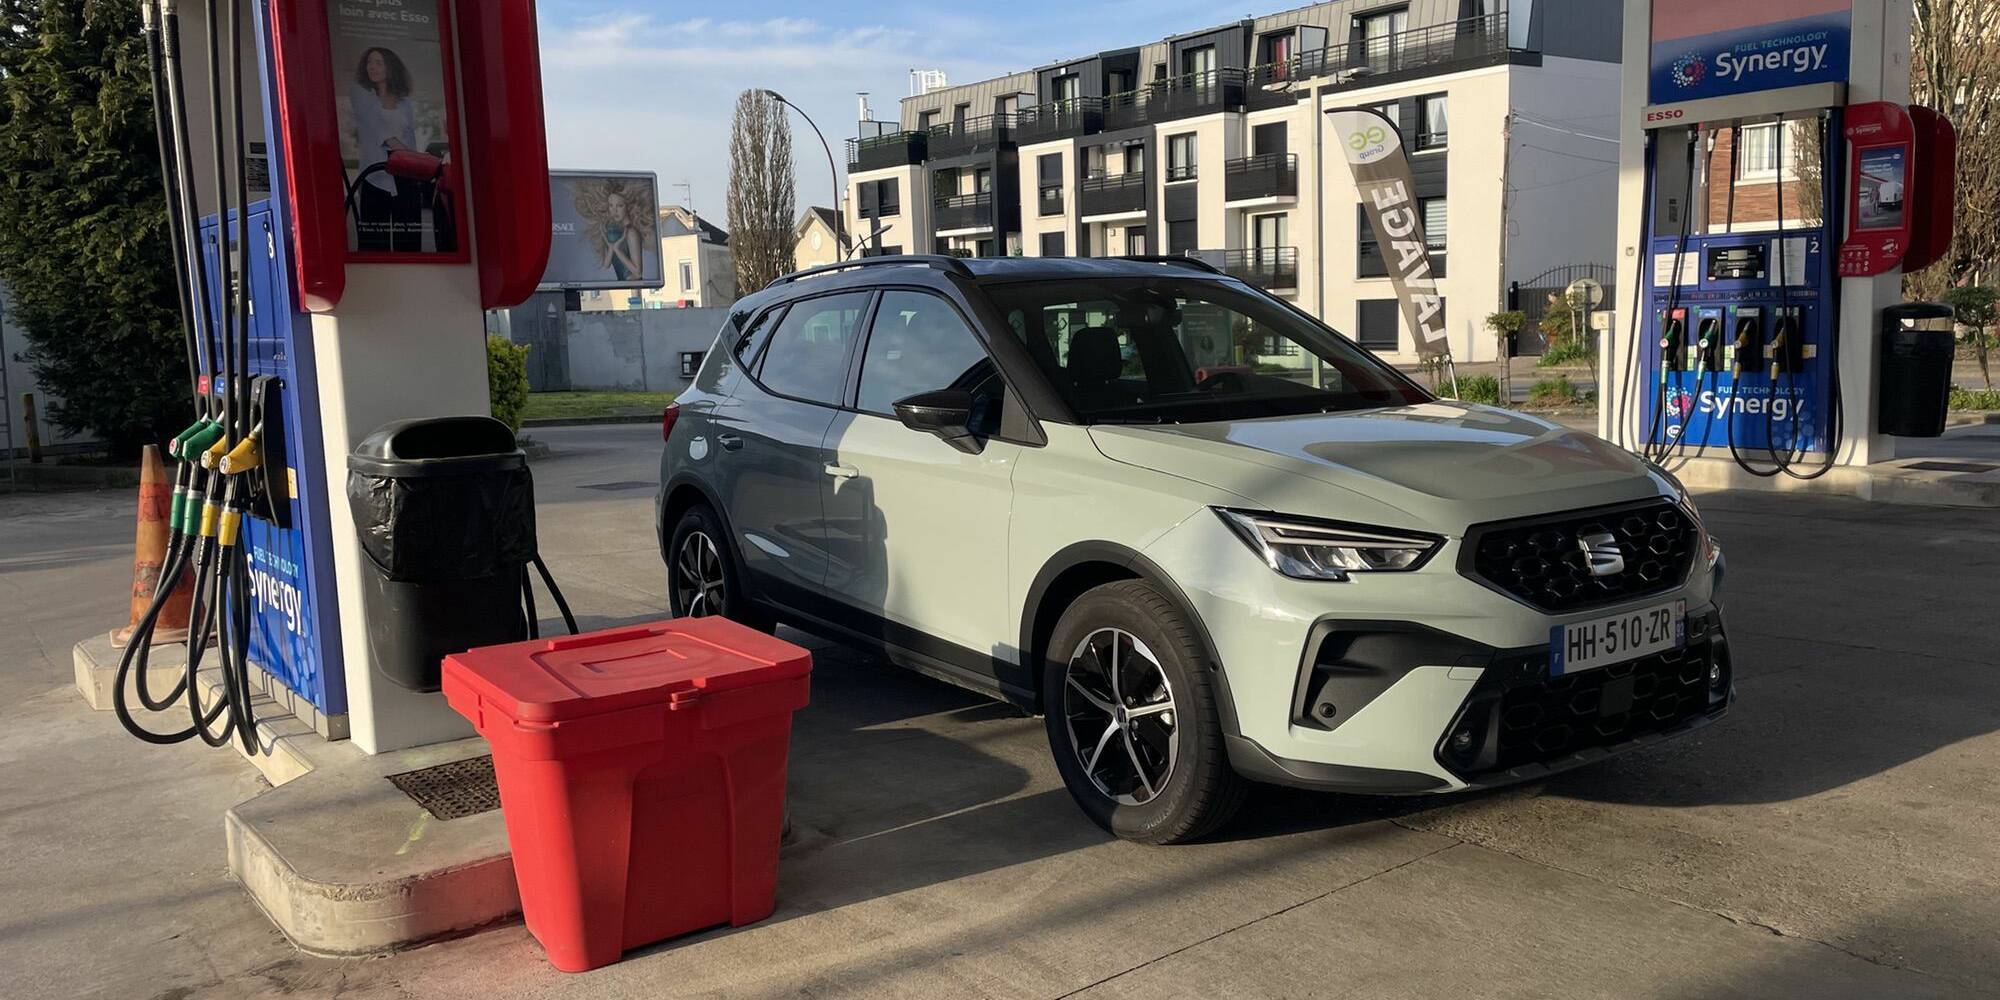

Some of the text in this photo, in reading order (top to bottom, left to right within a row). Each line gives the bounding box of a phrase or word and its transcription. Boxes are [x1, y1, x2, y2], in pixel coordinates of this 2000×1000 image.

[338, 4, 430, 24] loin avec Esso
[1735, 31, 1828, 52] FUEL TECHNOLOGY
[1715, 44, 1828, 82] Synergy
[1647, 109, 1684, 122] ESSO
[267, 231, 275, 260] 3
[1810, 241, 1820, 254] 2
[246, 553, 302, 636] Synergy
[1553, 652, 1561, 664] F
[1568, 608, 1671, 663] HH-510-ZR
